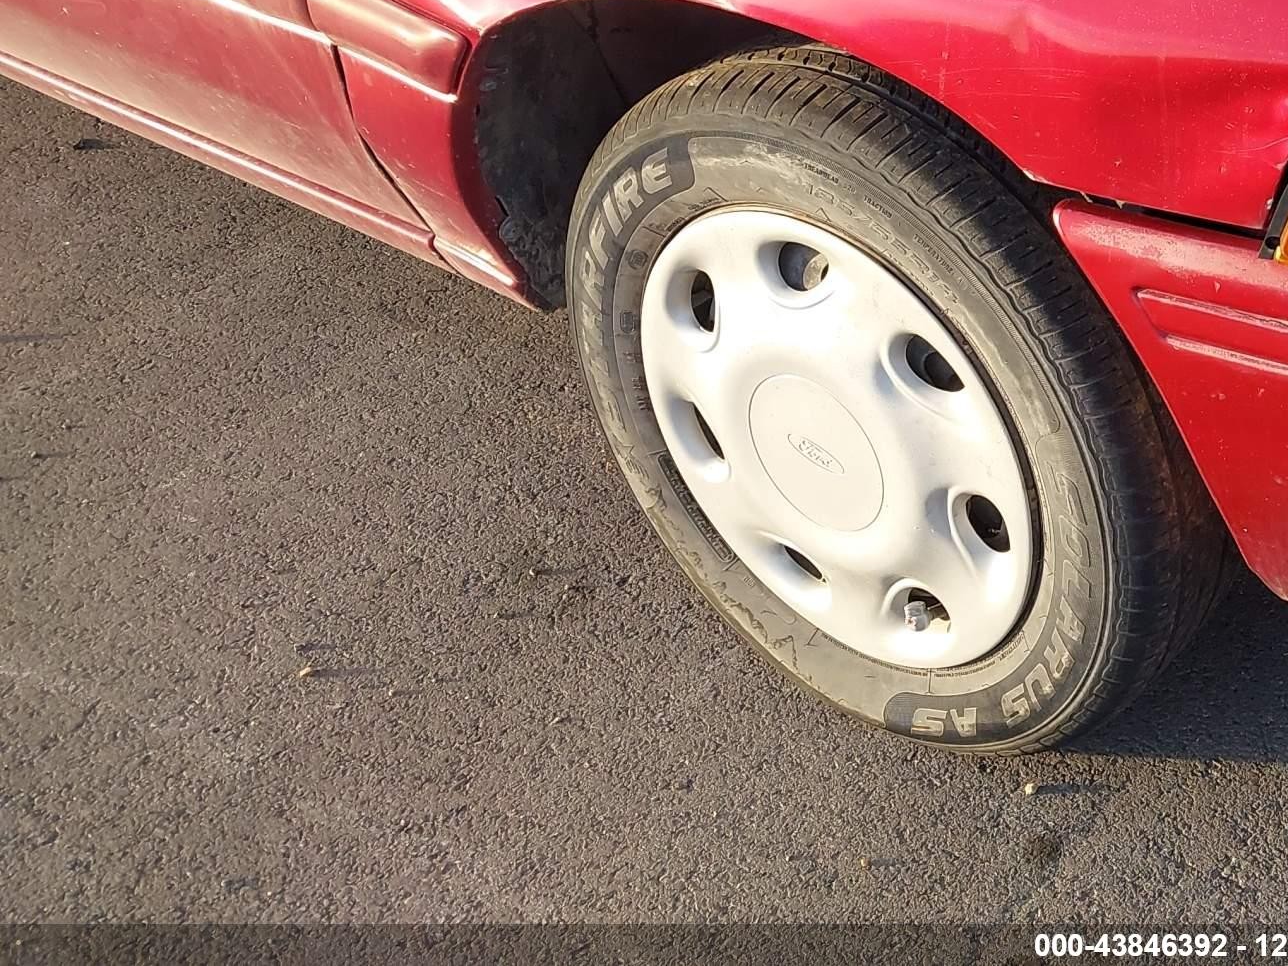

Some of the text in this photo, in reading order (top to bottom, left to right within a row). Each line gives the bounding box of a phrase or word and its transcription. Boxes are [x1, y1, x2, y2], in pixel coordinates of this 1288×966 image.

[578, 146, 674, 436] STARFIRE
[797, 438, 834, 468] Ford
[910, 460, 1093, 737] SOLARUS AS
